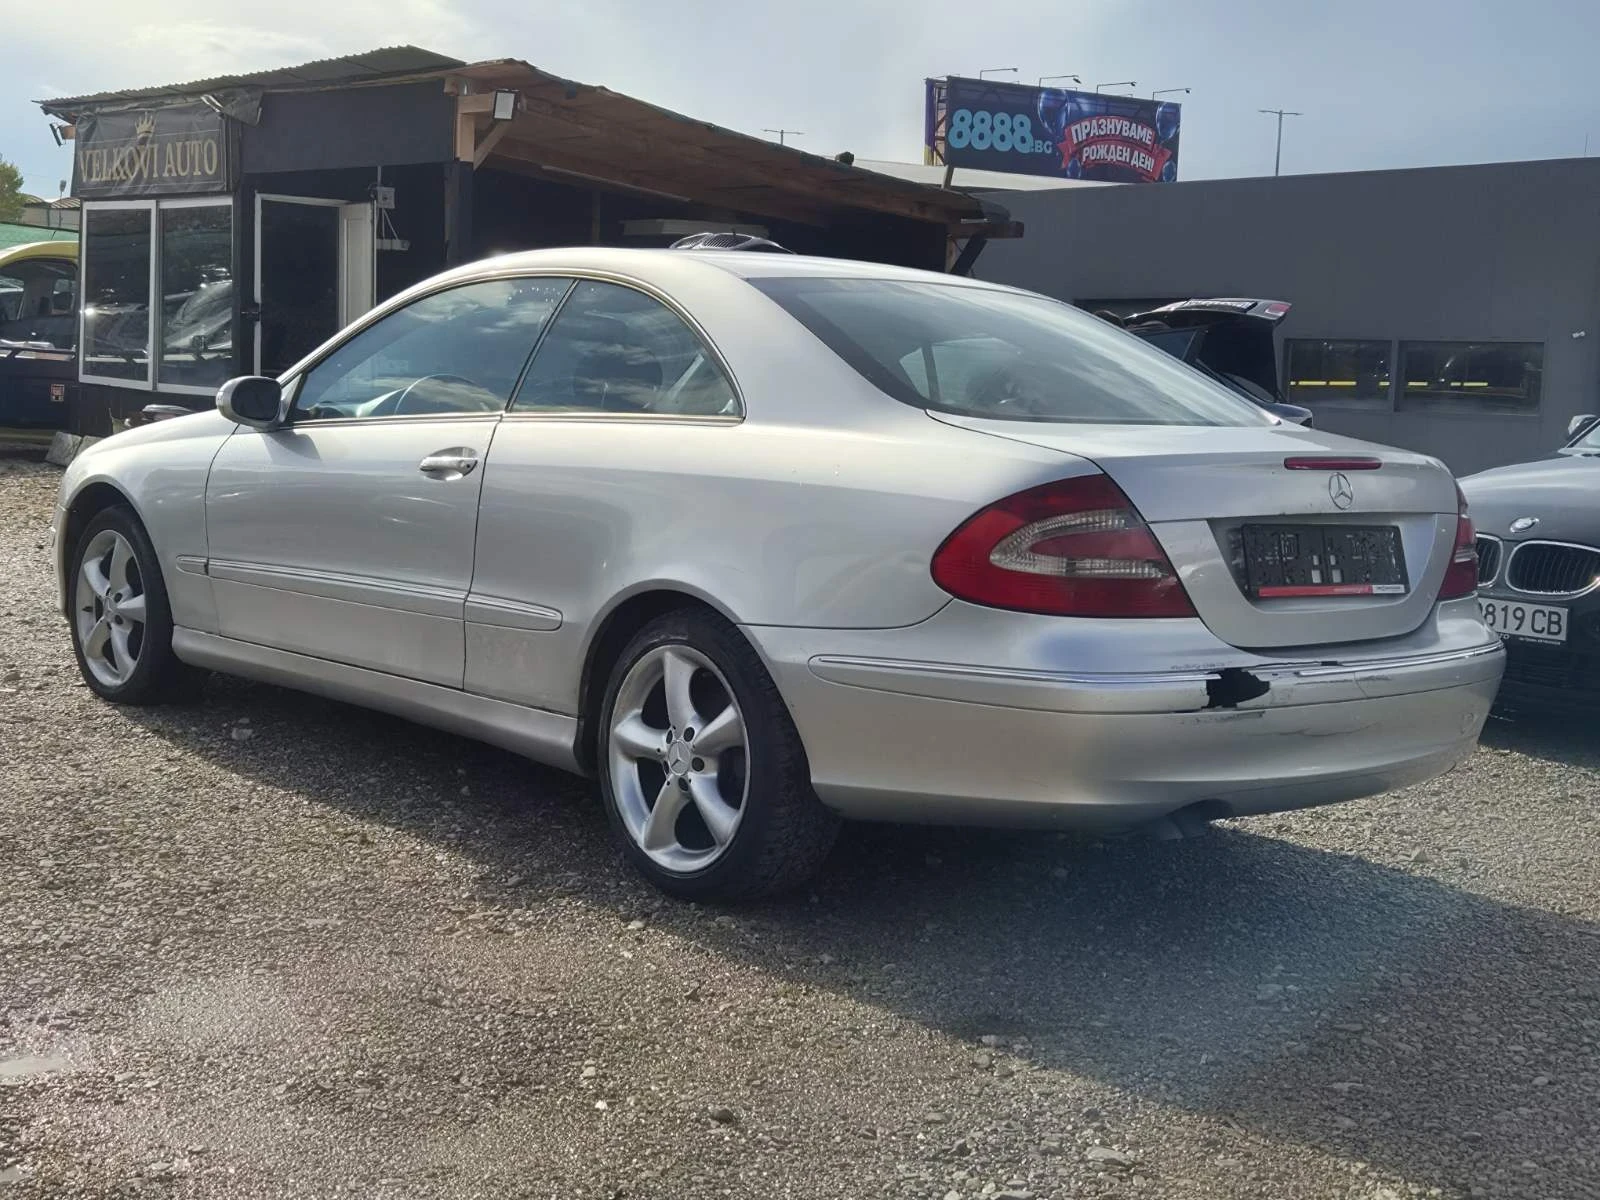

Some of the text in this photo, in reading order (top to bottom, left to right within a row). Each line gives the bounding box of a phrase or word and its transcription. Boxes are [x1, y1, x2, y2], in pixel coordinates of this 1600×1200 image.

[1071, 118, 1153, 145] ПРАЗНУВАМЕ
[79, 139, 218, 182] VELKOVI AUTO
[1082, 144, 1155, 172] РОЖДЕН ДЕН!
[1479, 602, 1526, 631] 819
